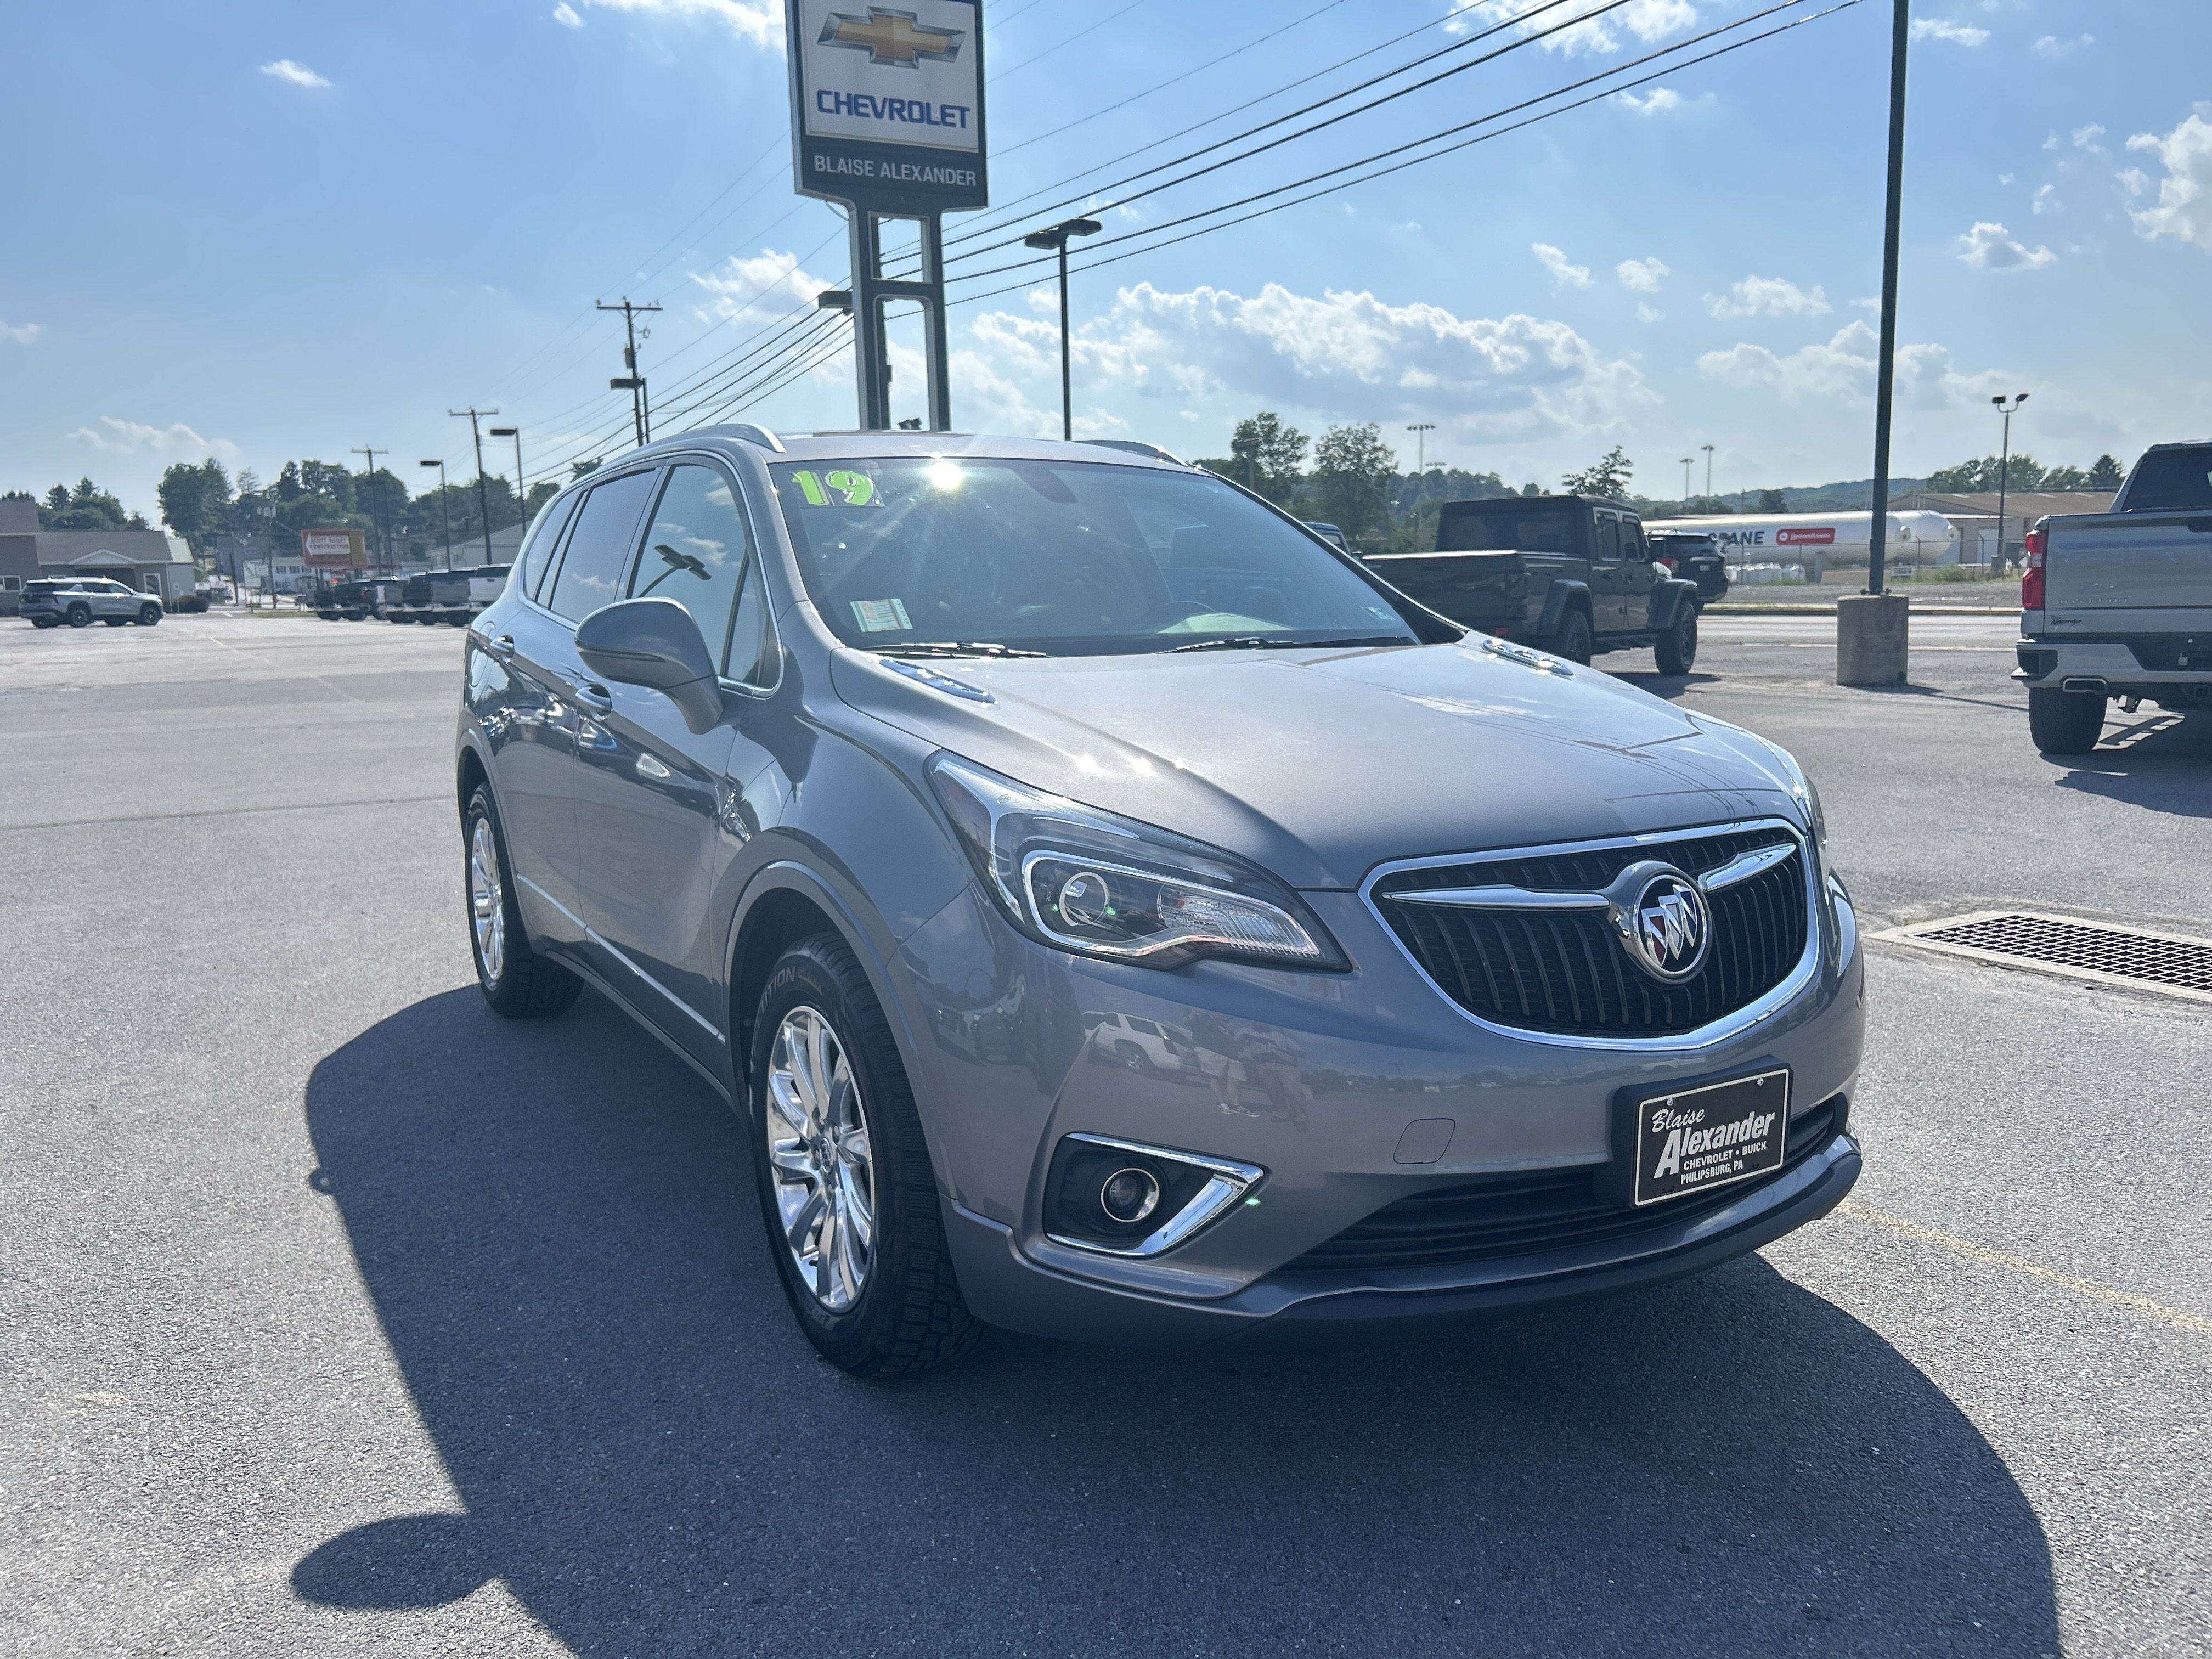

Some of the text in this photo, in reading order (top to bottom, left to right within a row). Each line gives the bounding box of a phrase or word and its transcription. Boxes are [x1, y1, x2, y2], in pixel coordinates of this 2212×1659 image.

[817, 89, 970, 128] CHEVROLET
[814, 155, 977, 187] BLAISE ALEXANDER
[791, 470, 874, 506] 19
[1651, 1109, 1705, 1133] Blaise
[1653, 1111, 1775, 1179] Alexander
[1683, 1141, 1767, 1170] CHEVROLET BUICK
[1734, 1159, 1743, 1170] PA
